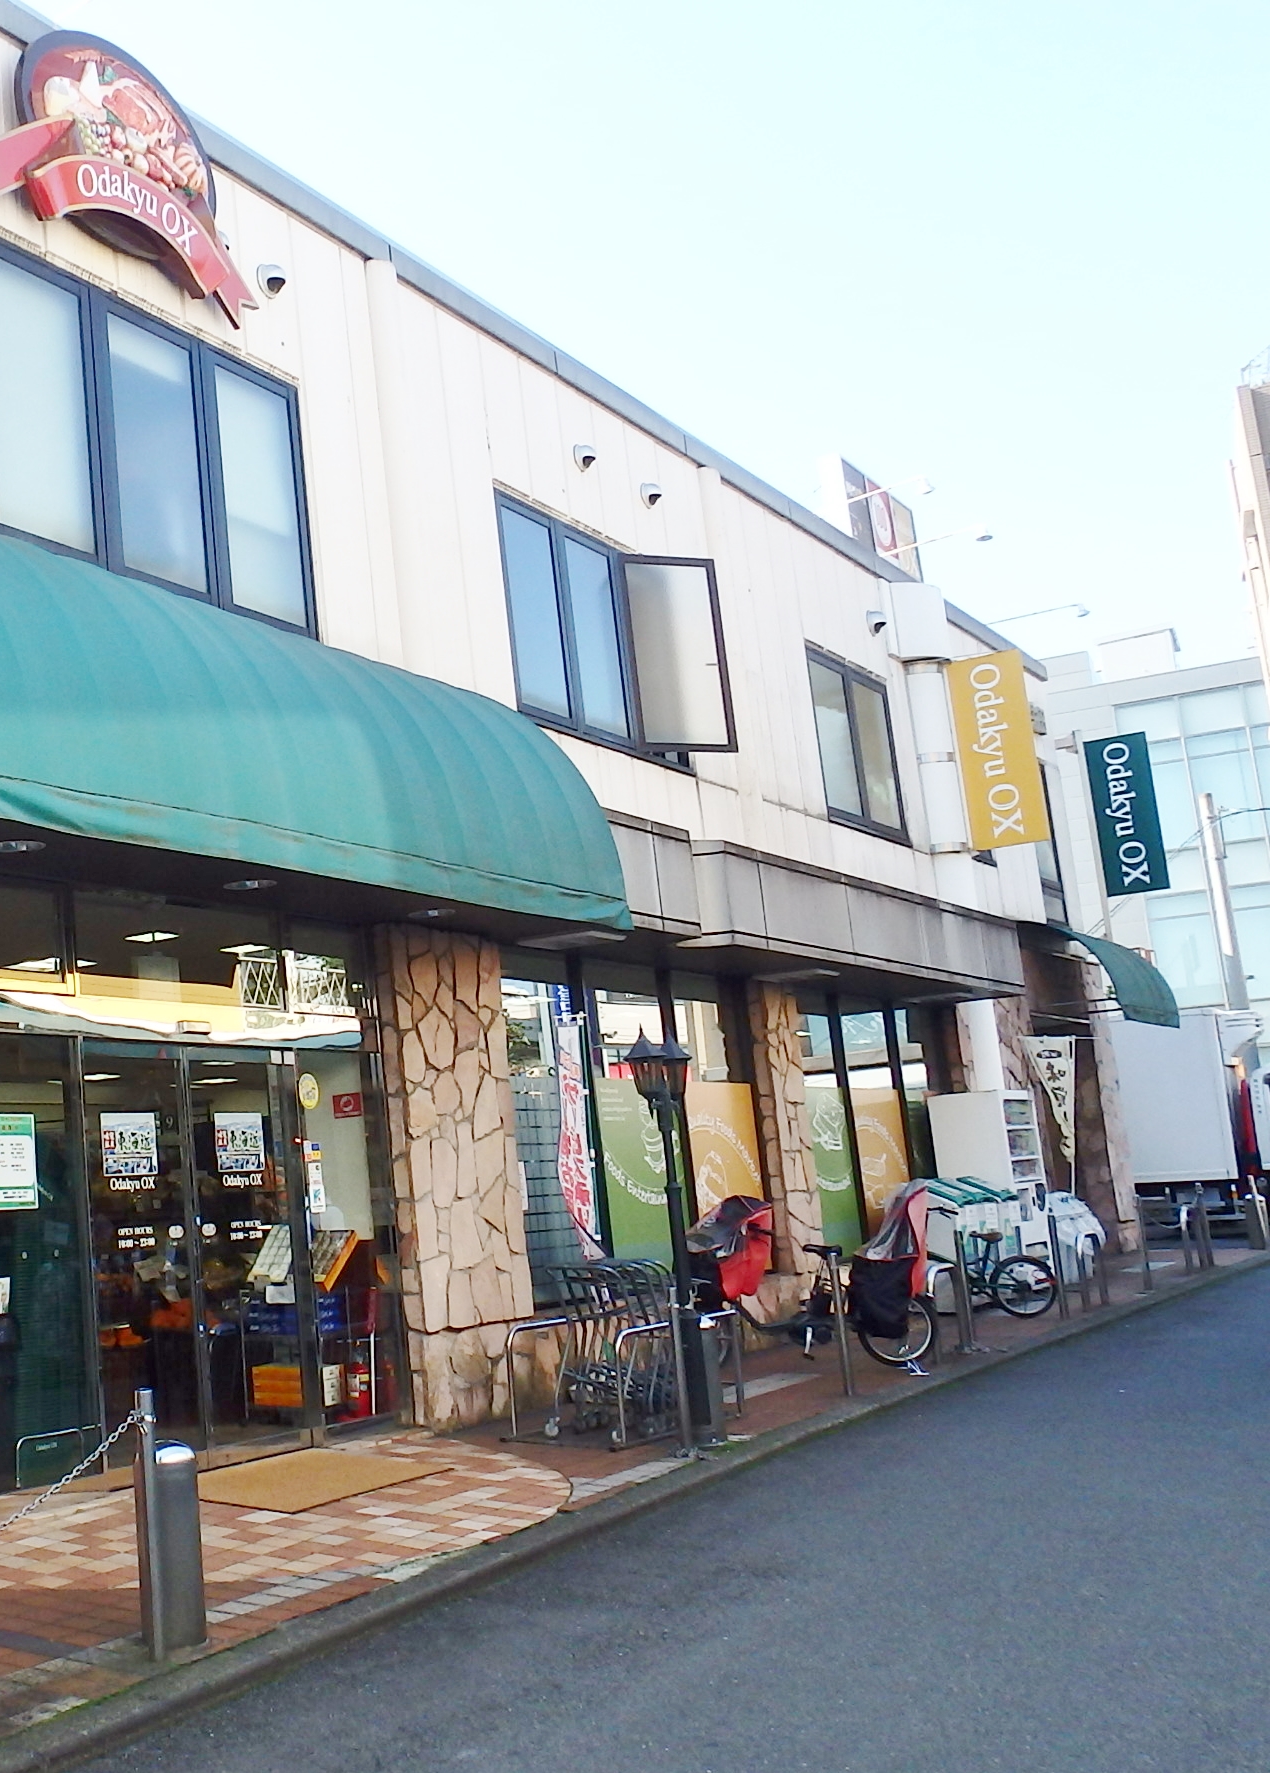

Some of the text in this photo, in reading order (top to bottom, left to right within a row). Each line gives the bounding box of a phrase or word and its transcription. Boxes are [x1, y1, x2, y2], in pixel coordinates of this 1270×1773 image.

[76, 163, 199, 257] Odakyu OX
[969, 662, 1026, 839] Odakyu OX
[1102, 741, 1152, 888] Odakyu OX
[109, 1176, 156, 1193] Odakyu OX
[223, 1173, 263, 1189] Odakyu OX
[603, 1151, 626, 1187] Foods
[117, 1227, 134, 1237] OPEN
